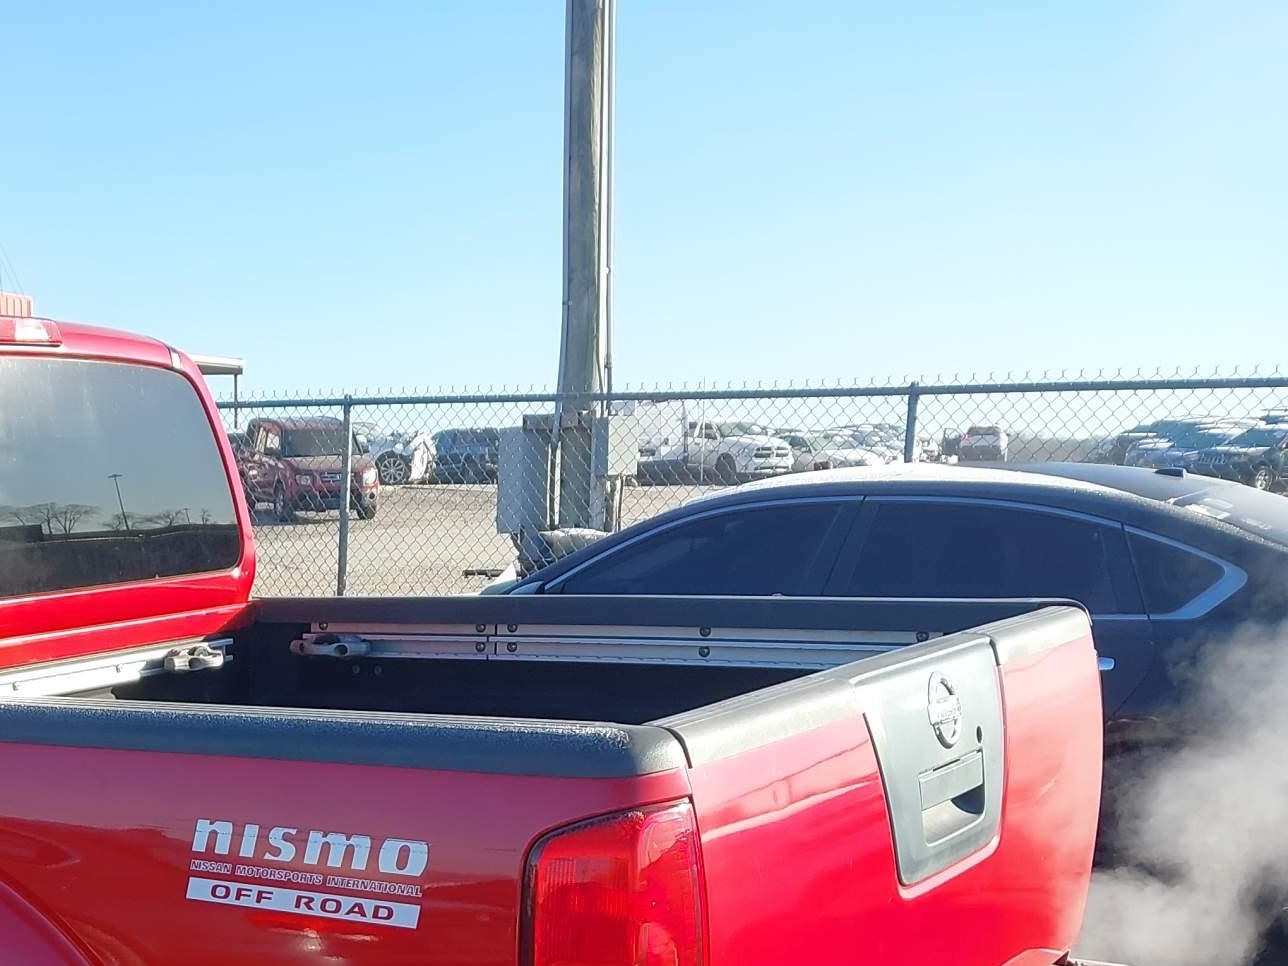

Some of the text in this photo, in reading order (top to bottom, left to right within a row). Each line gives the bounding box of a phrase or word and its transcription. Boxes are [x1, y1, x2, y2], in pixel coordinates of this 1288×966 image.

[191, 818, 430, 877] nismo
[189, 859, 423, 897] NISSAN MOTORSPORTS INTERNATIONAL
[210, 884, 395, 921] OFF ROAD
